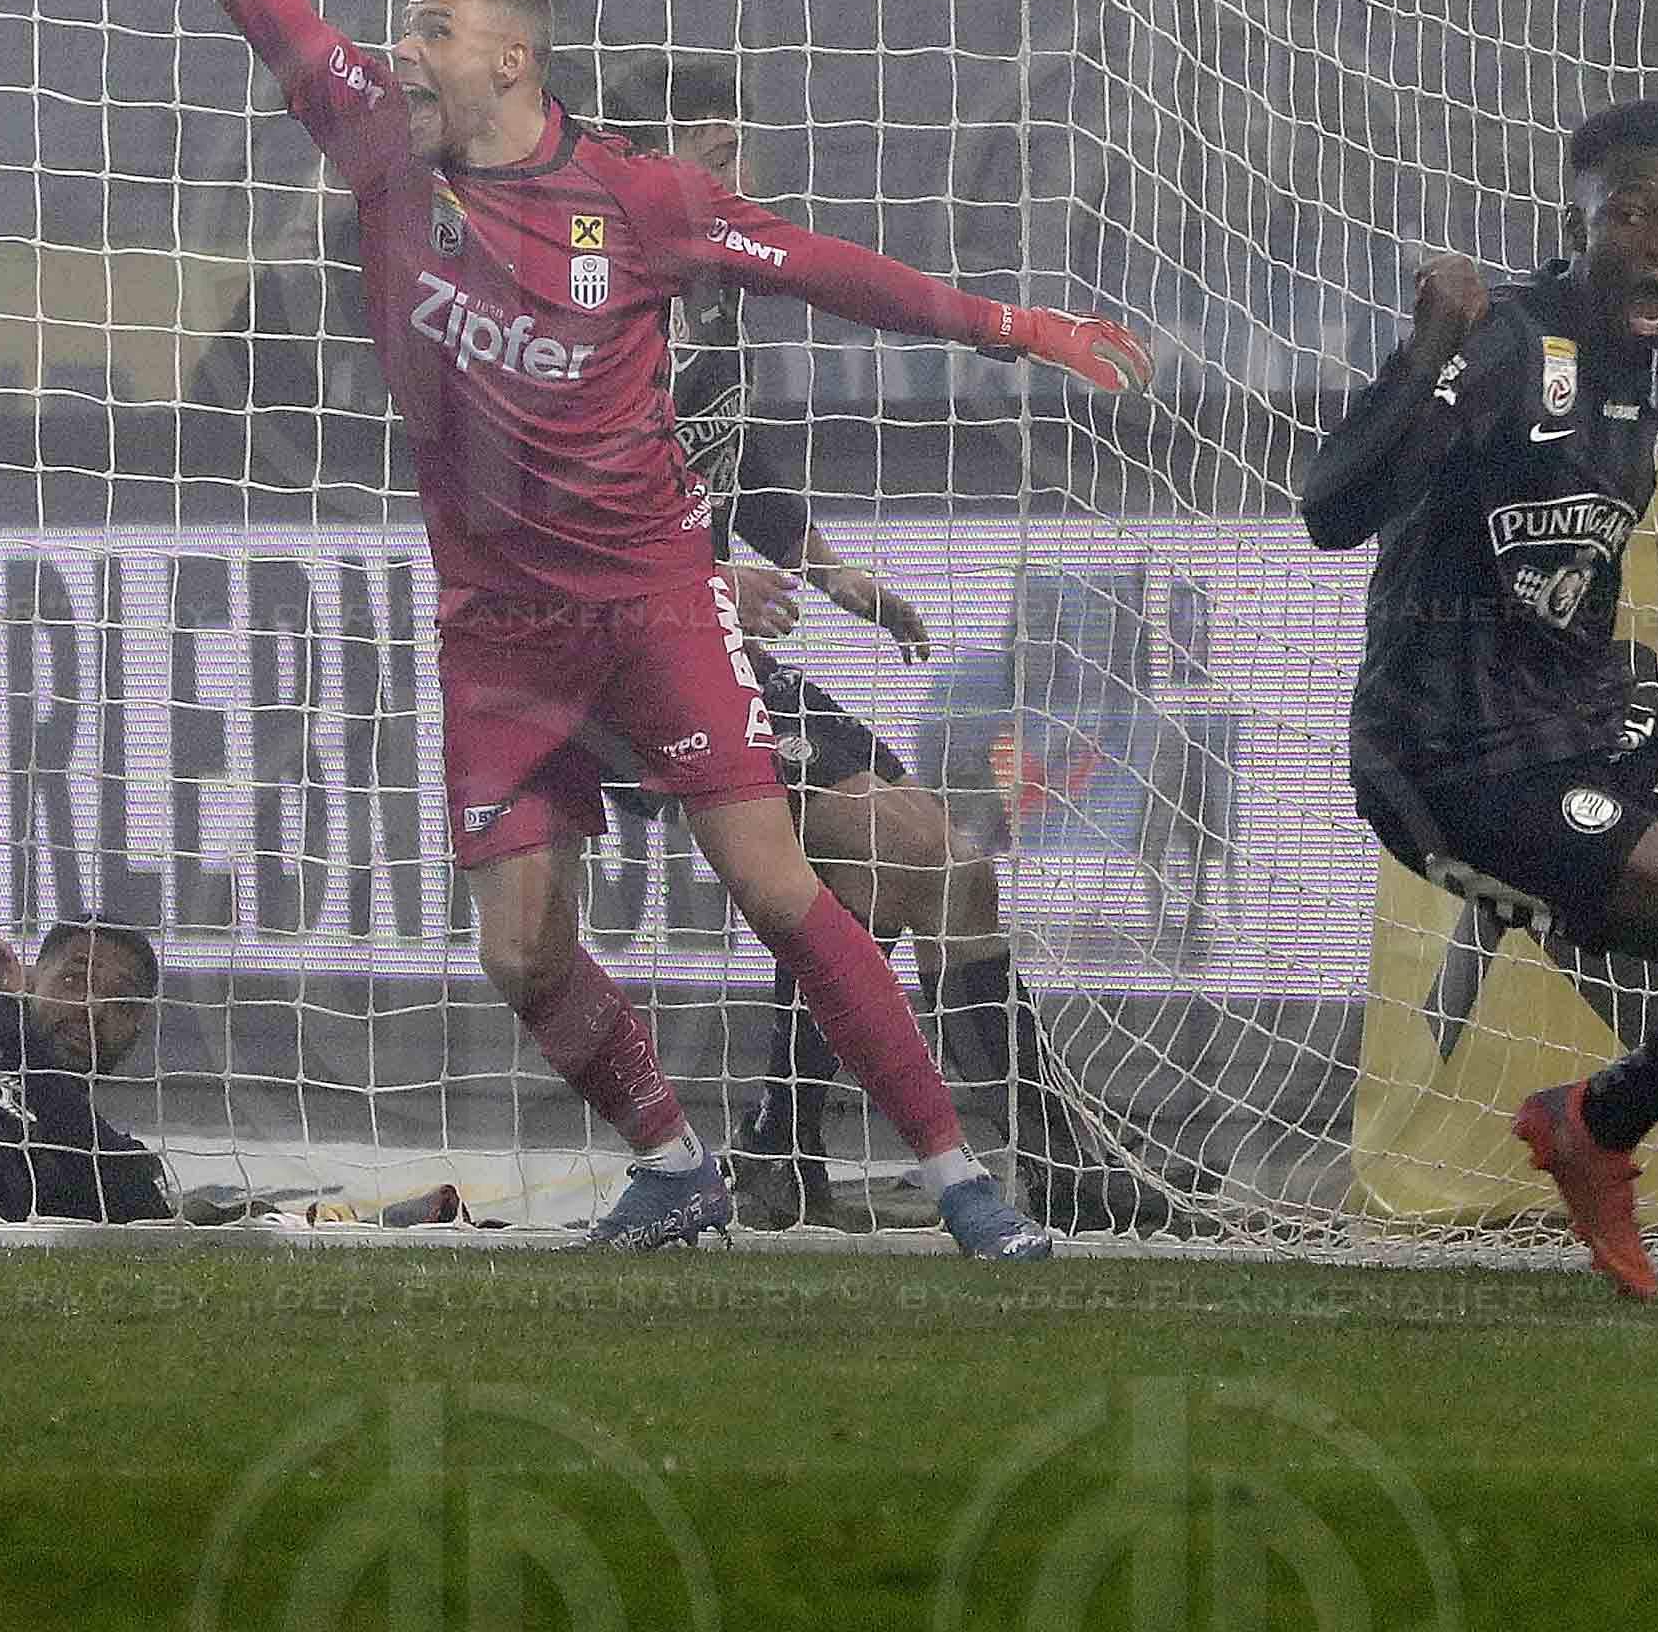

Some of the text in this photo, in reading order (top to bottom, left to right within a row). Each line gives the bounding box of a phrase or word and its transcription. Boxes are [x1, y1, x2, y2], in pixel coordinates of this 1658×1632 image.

[725, 231, 788, 268] BWT
[573, 274, 606, 283] LASK
[410, 270, 599, 380] Zipfer
